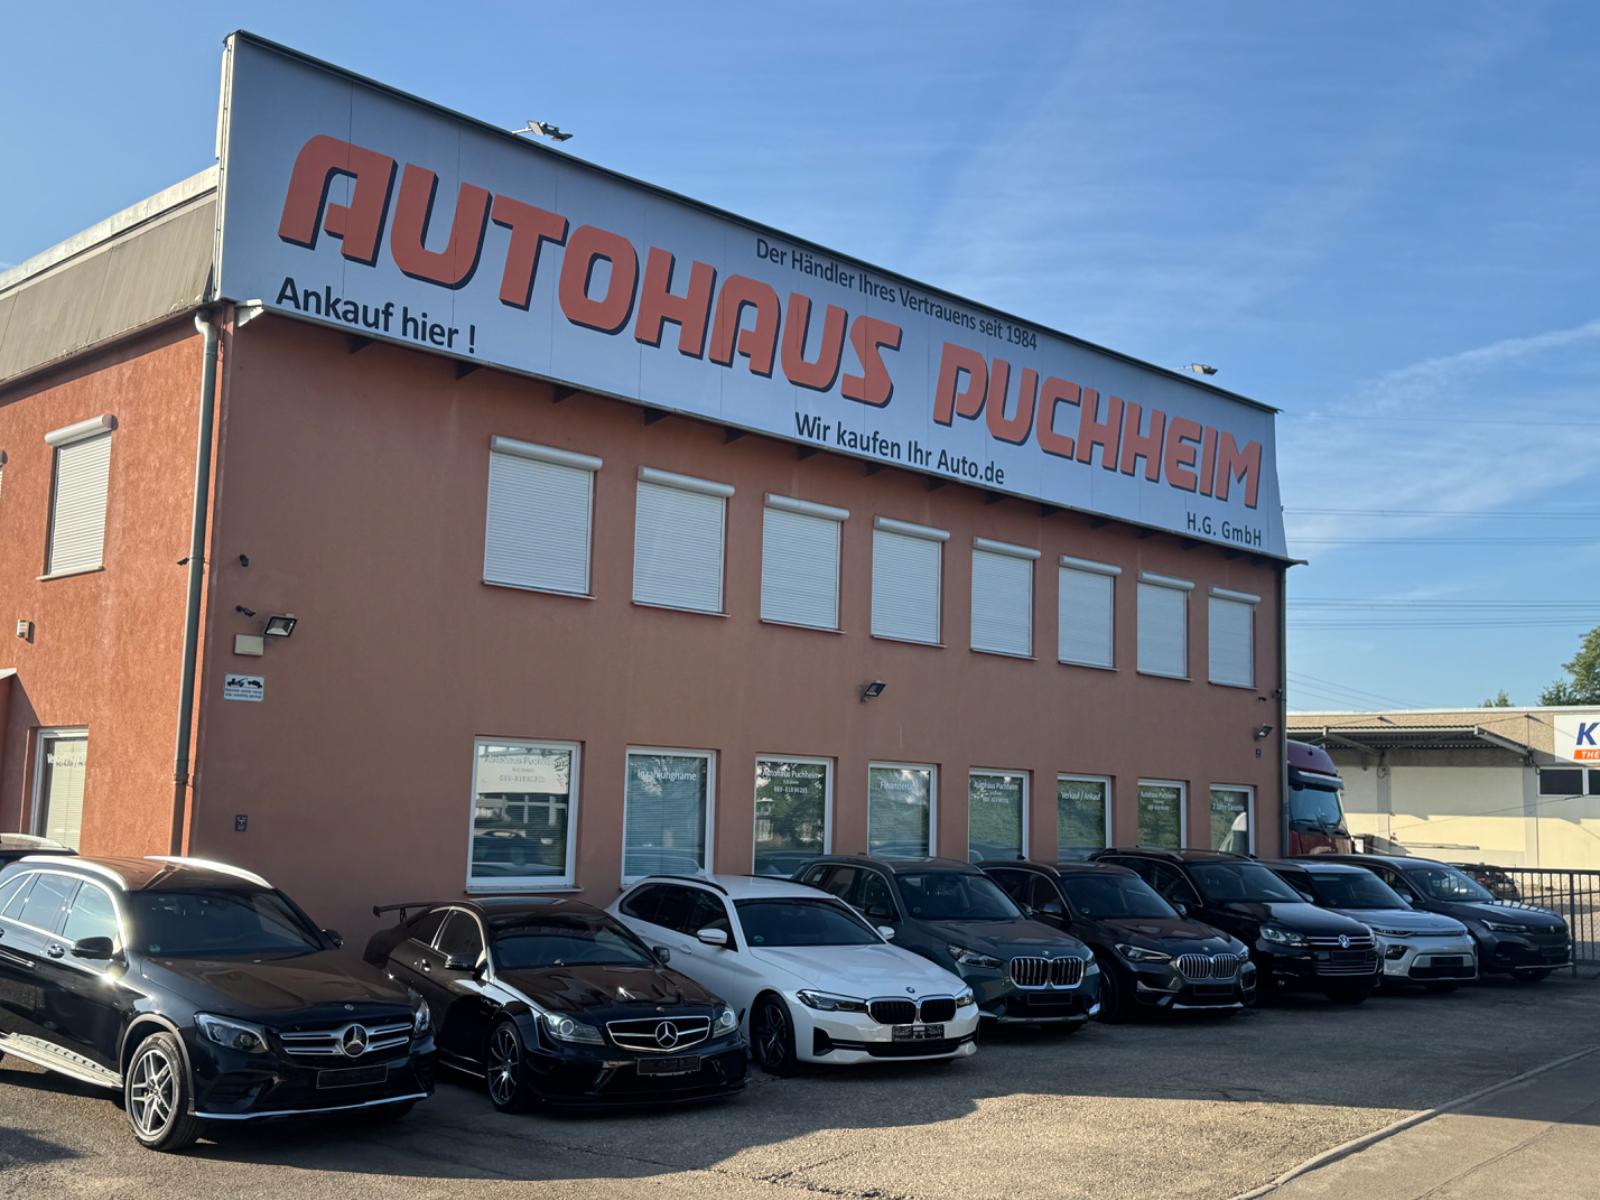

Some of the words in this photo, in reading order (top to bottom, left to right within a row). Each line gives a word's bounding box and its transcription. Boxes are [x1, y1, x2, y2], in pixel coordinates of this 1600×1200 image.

[276, 276, 394, 332] Ankauf
[402, 306, 459, 349] hier
[468, 324, 476, 354] !
[278, 134, 903, 408] AUTOHAUS
[933, 342, 1263, 509] PUCHHEIM
[756, 238, 787, 266] Der
[791, 249, 855, 288] Händler
[859, 273, 896, 303] Ihres
[900, 287, 976, 330] Vertrauens
[979, 317, 1002, 340] seit
[1006, 325, 1037, 350] 1984
[795, 411, 831, 442] Wir
[837, 420, 900, 459] kaufen
[908, 440, 932, 467] Ihr
[937, 449, 1005, 485] Auto.de
[1187, 511, 1217, 537] H.G.
[1222, 520, 1262, 547] GmbH
